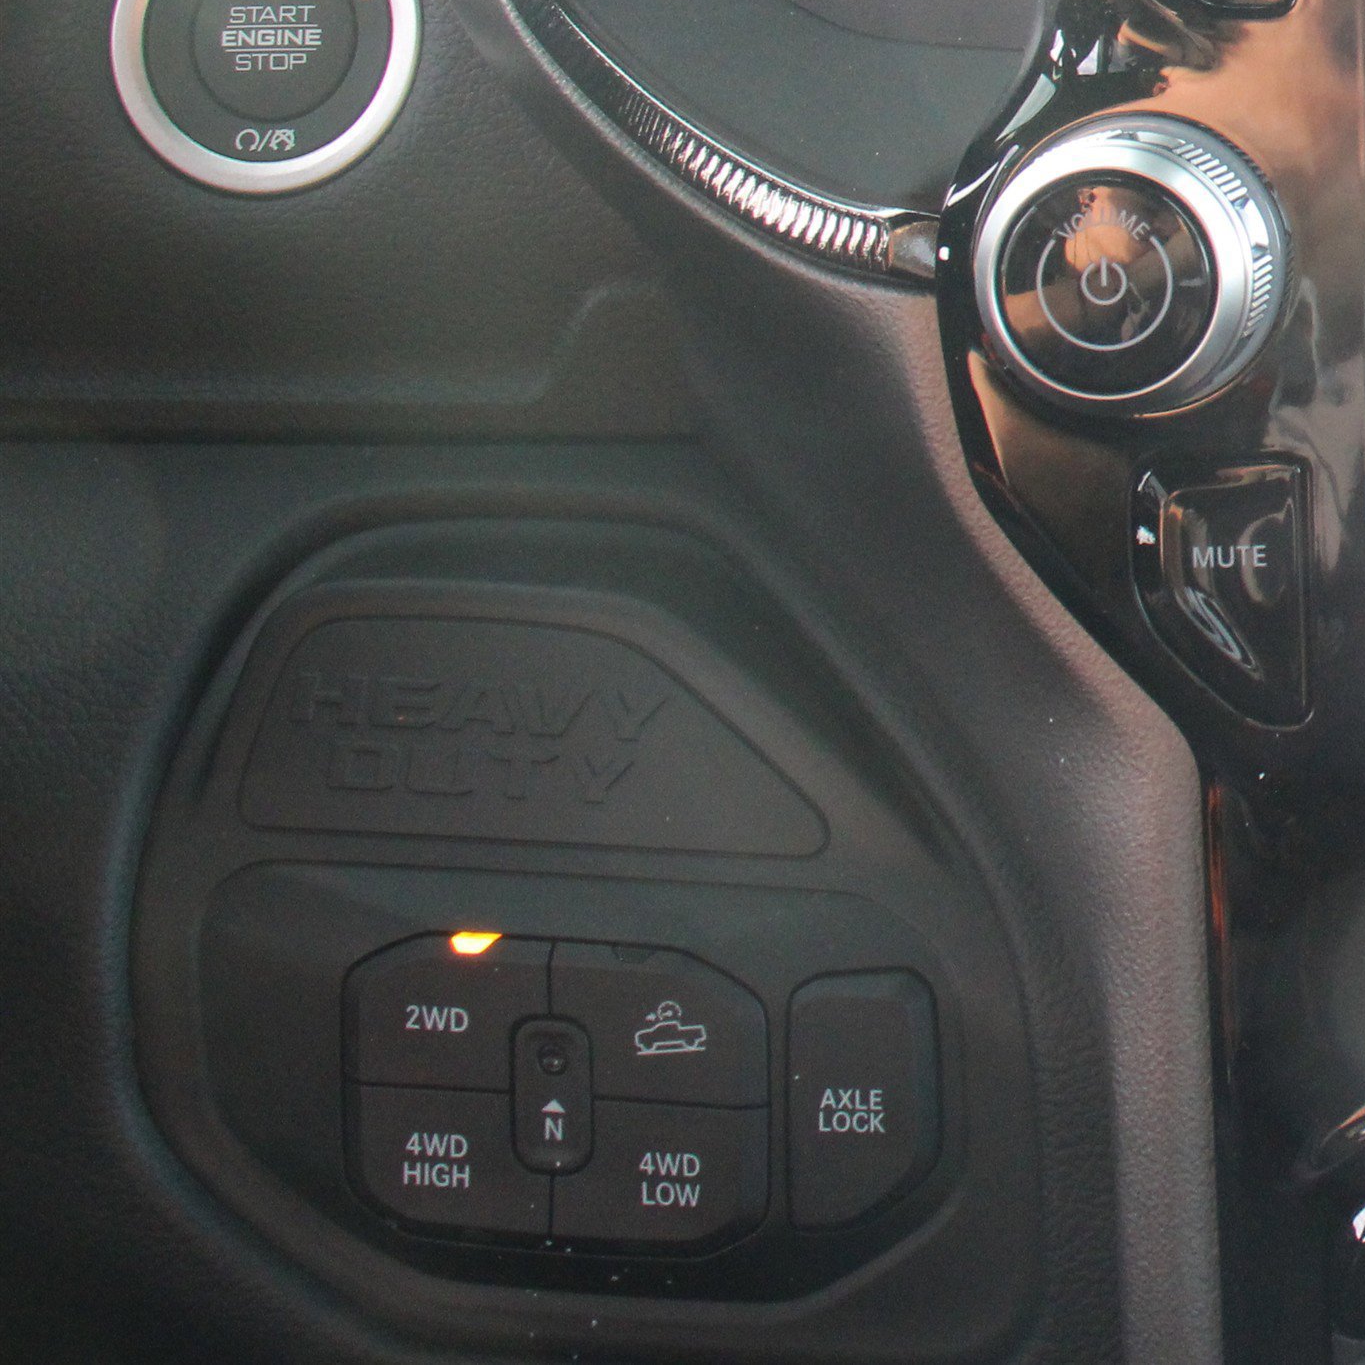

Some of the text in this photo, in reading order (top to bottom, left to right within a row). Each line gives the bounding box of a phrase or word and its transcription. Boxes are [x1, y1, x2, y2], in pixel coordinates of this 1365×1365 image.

[229, 5, 316, 24] START
[221, 29, 322, 47] ENGINE
[235, 53, 307, 71] STOP
[1192, 545, 1268, 569] MUTE
[287, 670, 674, 744] HEAVY
[404, 1005, 469, 1032] 2WD
[818, 1088, 884, 1111] AXLE
[544, 1116, 564, 1142] N
[817, 1111, 886, 1134] LOCK
[405, 1132, 468, 1160] 4WD
[402, 1161, 470, 1188] HIGH
[638, 1151, 700, 1179] 4WD
[641, 1181, 701, 1208] LOW
